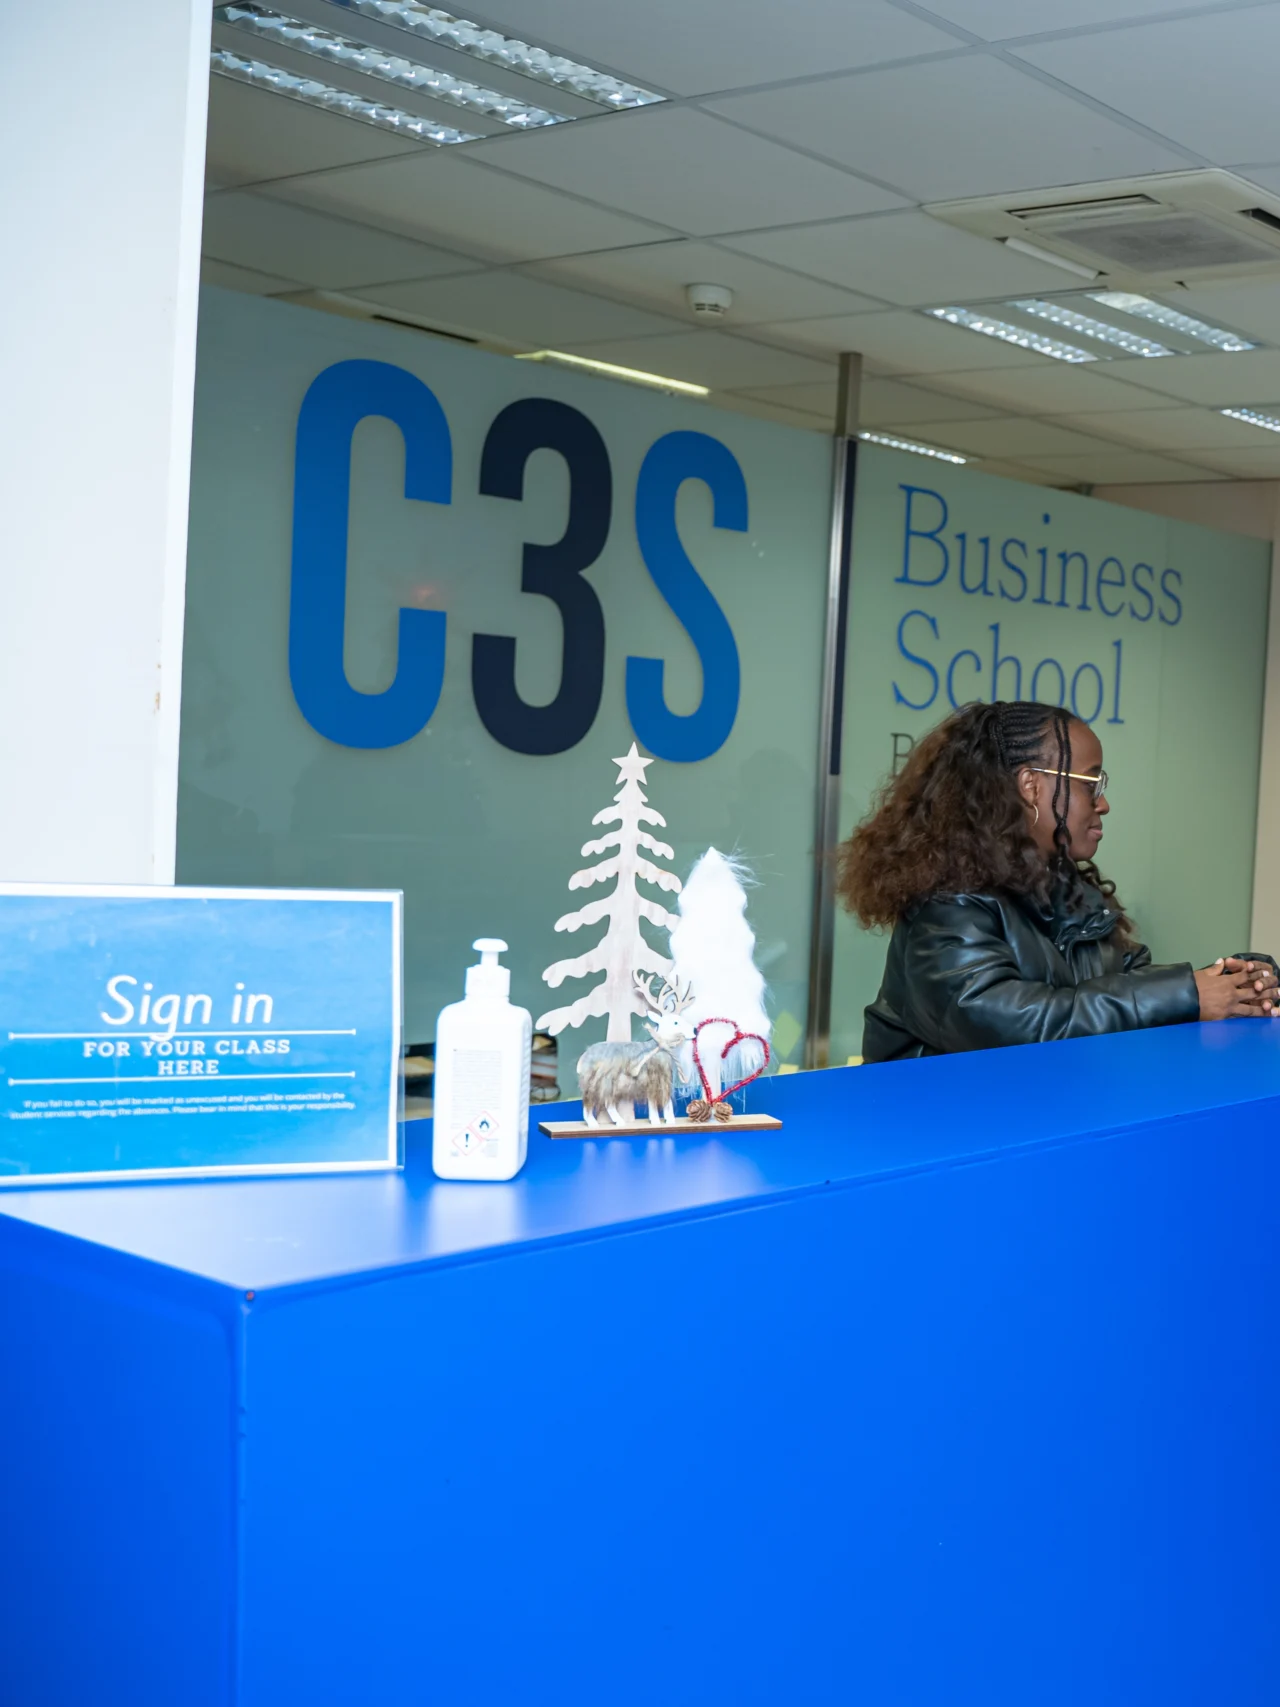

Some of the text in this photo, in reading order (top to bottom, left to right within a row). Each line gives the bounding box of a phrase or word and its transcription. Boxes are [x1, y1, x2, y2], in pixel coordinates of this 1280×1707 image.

[288, 358, 749, 763] C3S
[894, 483, 1183, 626] Business
[891, 609, 1125, 725] School
[82, 1039, 290, 1058] FOR YOUR CLASS
[100, 975, 274, 1042] Sign in
[158, 1059, 219, 1076] HERE
